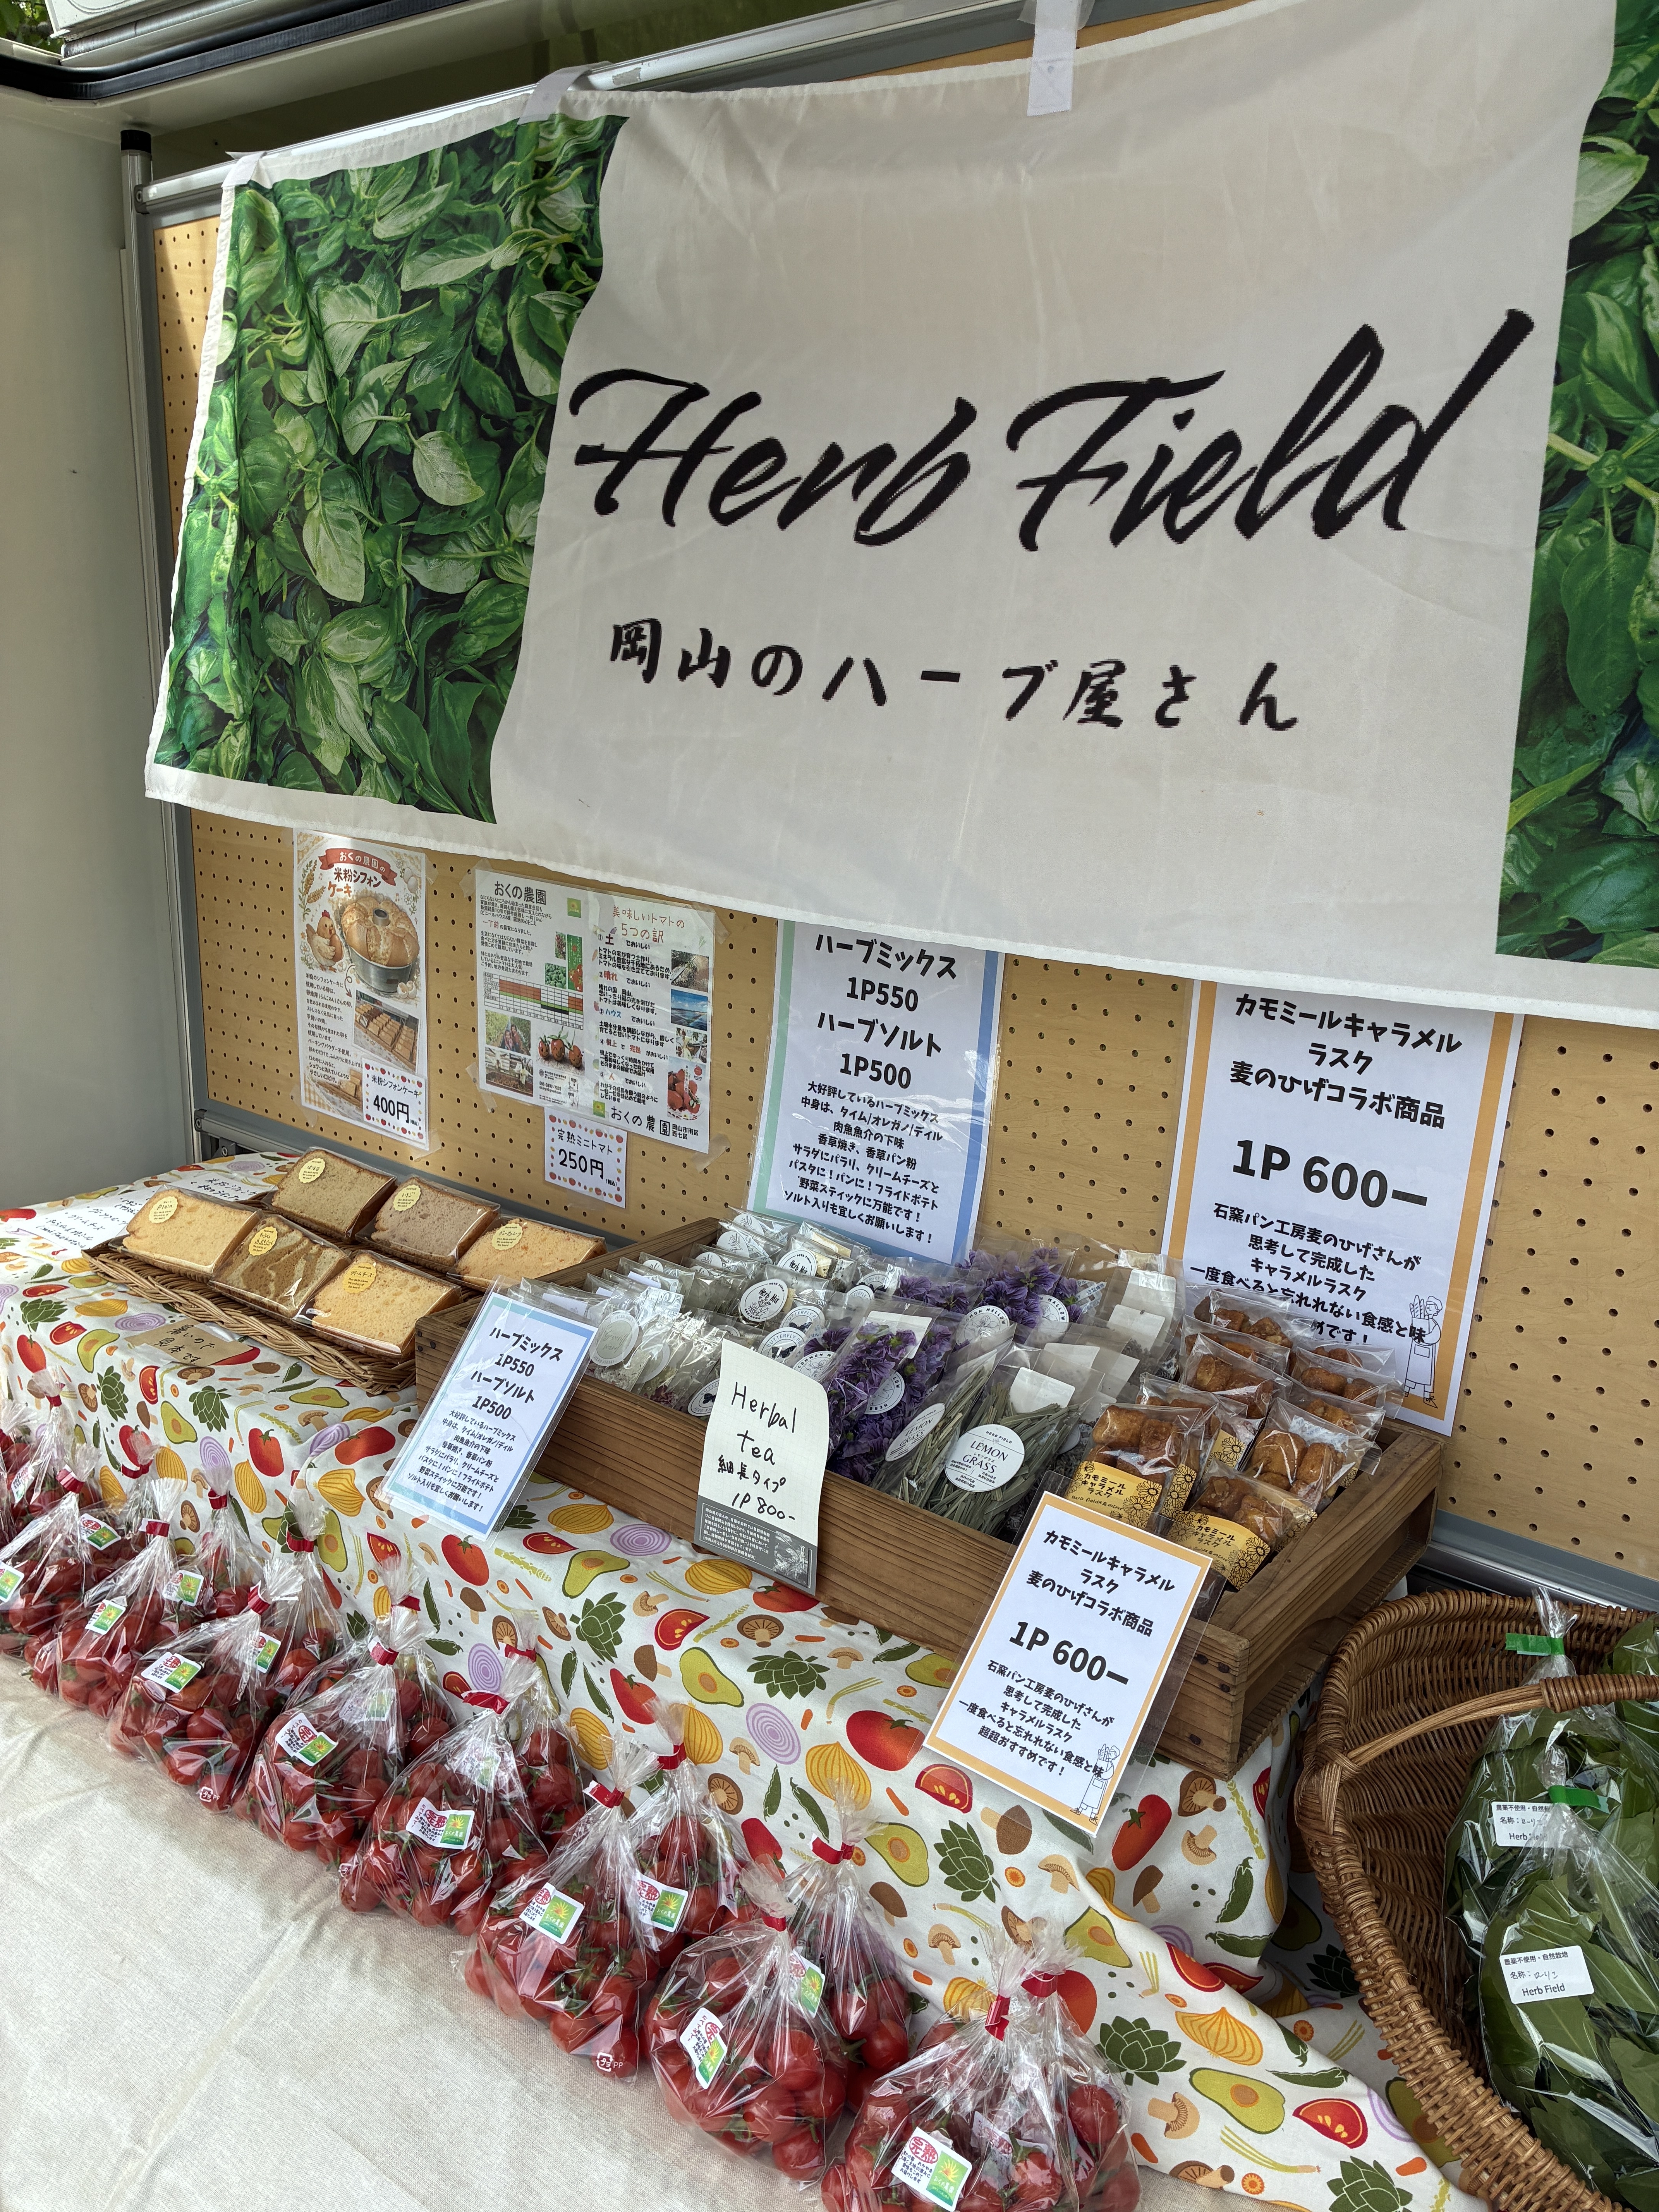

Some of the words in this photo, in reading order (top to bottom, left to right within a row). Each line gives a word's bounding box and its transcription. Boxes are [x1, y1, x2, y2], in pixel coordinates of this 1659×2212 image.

[568, 368, 977, 547] Herb
[1006, 308, 1535, 551] Field
[610, 617, 1297, 729] 岡山のハーブ屋さん
[339, 851, 385, 872] おくの農園の
[328, 881, 352, 898] ケーキ
[333, 867, 381, 888] 米粉シフォン
[494, 881, 546, 905] おくの農園
[613, 905, 685, 928] 美味しいトマトの
[605, 934, 614, 945] 土
[626, 940, 650, 950] でおいしい
[621, 923, 664, 943] 5つの訳
[815, 934, 957, 980] ハーブミックス
[604, 970, 618, 982] 晴れ
[626, 978, 651, 988] でおいしい
[847, 977, 919, 1012] 1P550
[605, 1008, 622, 1018] ハウス
[631, 1016, 655, 1026] でおいしい
[1235, 994, 1463, 1053] カモミールキャラメル
[817, 1012, 941, 1057] ハーブソルト
[840, 1053, 911, 1089] 1P500
[1309, 1042, 1373, 1075] ラスク
[371, 1075, 419, 1098] 米粉シフォンケーキ
[625, 1078, 646, 1088] でおいしい
[1230, 1061, 1445, 1129] 麦のひげコラボ商品
[373, 1095, 409, 1124] 400円
[807, 1081, 939, 1123] 大好評しているハーブミックス
[558, 1128, 613, 1156] 完熟ミニトマト
[833, 1121, 905, 1150] 肉魚魚介の下味
[558, 1148, 604, 1180] 250円
[817, 1133, 917, 1170] 香草焼き、香草パン粉
[1233, 1140, 1290, 1180] 1P
[1213, 1203, 1421, 1271] 石窯パン工房麦のひげさんが
[1248, 1234, 1375, 1281] 思考して完成した
[1251, 1257, 1366, 1302] キャラメルラスク
[986, 1308, 1006, 1324] MALLOW
[1048, 1298, 1065, 1320] MALLOW
[154, 1338, 201, 1363] 見本です
[489, 1328, 563, 1362] ハーブミックス
[766, 1333, 796, 1348] BUTTERFLY
[494, 1353, 534, 1377] 1P550
[471, 1371, 534, 1403] ハーブソルト
[472, 1396, 512, 1420] 1P500
[731, 1381, 797, 1433] Herbal
[899, 1429, 925, 1447] GRASS
[905, 1417, 934, 1437] LEMON
[737, 1430, 775, 1465] tea
[970, 1440, 1009, 1462] LEMON
[962, 1454, 997, 1474] GRASS
[1082, 1479, 1123, 1495] キャラメル
[1084, 1473, 1126, 1489] カモミール
[1087, 1487, 1113, 1498] ラスク
[1196, 1525, 1235, 1541] カモミール
[1197, 1537, 1220, 1548] ラスク
[1043, 1530, 1175, 1592] カモミールキャラメル
[1080, 1569, 1119, 1594] ラスク
[1026, 1570, 1154, 1637] 麦のひげコラボ商品
[1009, 1621, 1050, 1653] 1P
[987, 1660, 1115, 1728] 石窯パン工房麦のひげさんが
[1003, 1686, 1082, 1731] 思考して完成した
[1000, 1702, 1073, 1743] キャラメルラスク
[958, 1701, 1104, 1778] 一度食べると忘れれない食感と味
[1508, 1832, 1528, 1840] Herb
[1504, 1951, 1569, 1966] 農薬不使用・自然栽培
[1522, 1986, 1543, 1997] Herb
[1544, 1983, 1566, 1994] Field
[911, 2137, 938, 2164] 完熟
